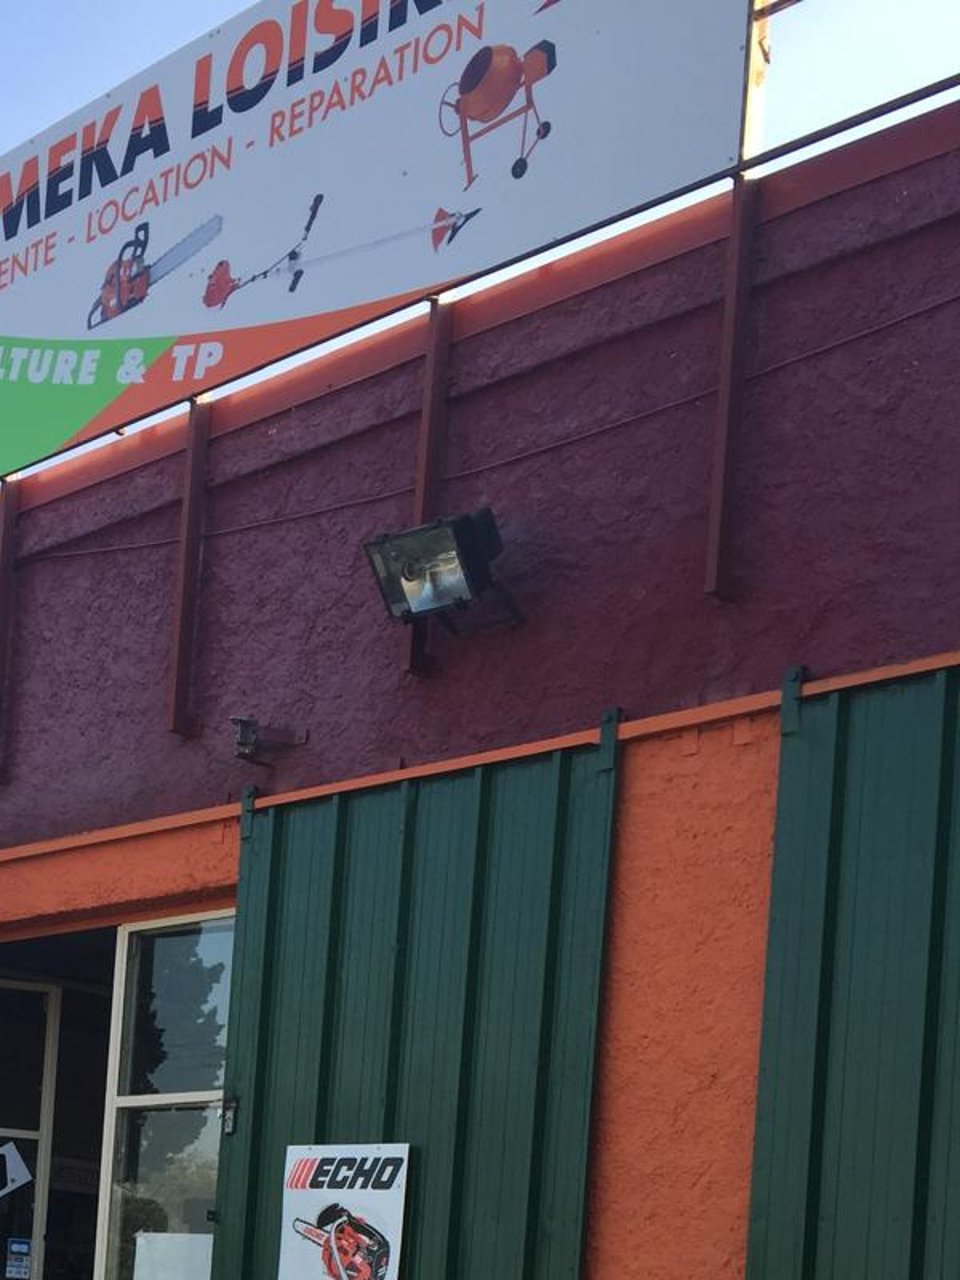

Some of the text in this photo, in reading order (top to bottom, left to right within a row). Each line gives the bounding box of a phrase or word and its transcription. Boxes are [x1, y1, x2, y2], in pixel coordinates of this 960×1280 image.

[86, 136, 234, 244] LOCATION
[268, 2, 485, 148] REPARATION
[116, 348, 146, 385] &
[171, 341, 224, 382] TP
[308, 1156, 405, 1190] ECHO
